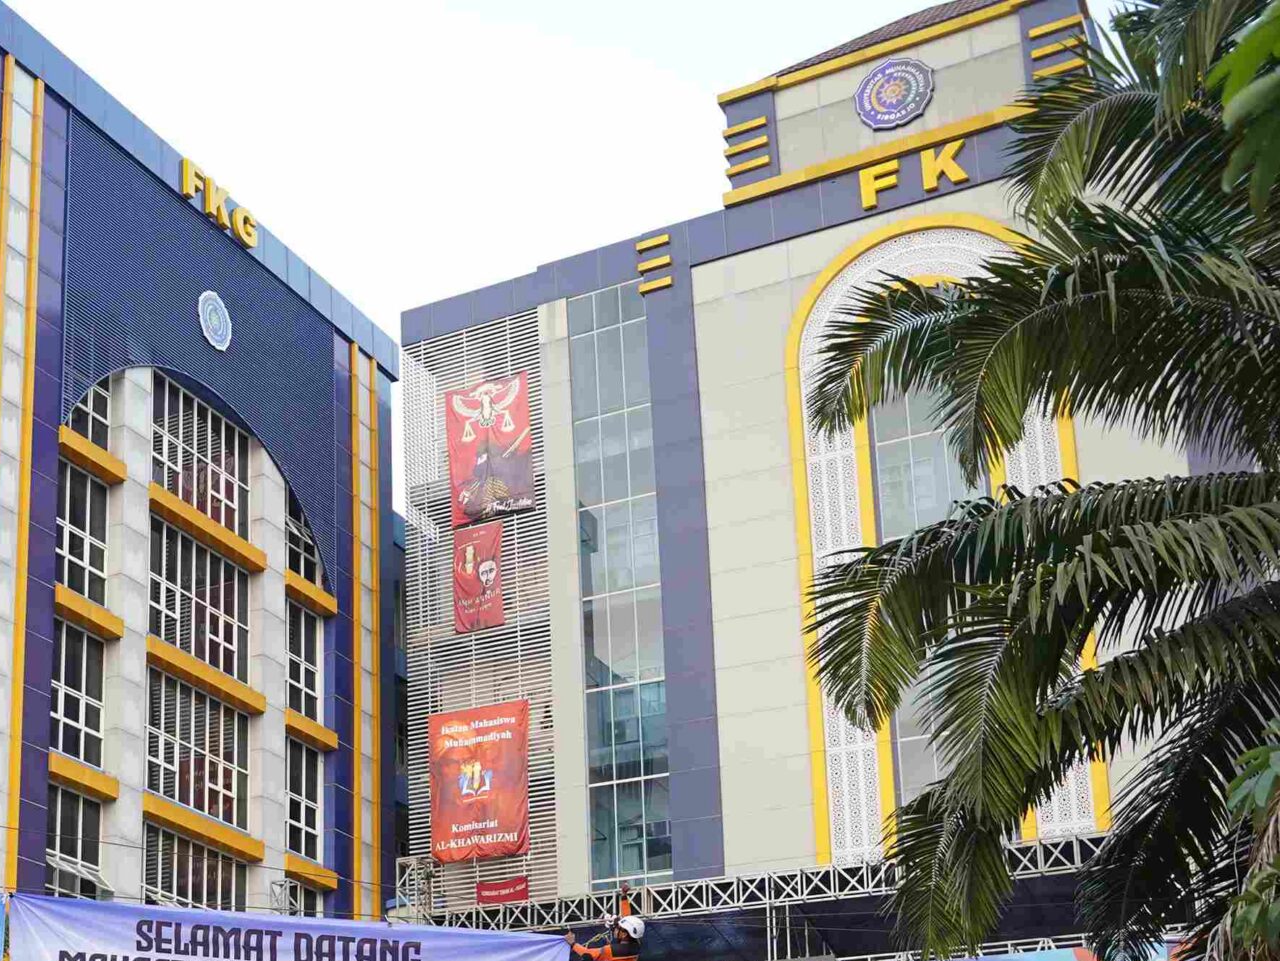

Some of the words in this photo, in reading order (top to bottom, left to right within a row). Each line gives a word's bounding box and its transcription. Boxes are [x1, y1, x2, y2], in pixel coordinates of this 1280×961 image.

[179, 157, 258, 249] FKG
[469, 716, 516, 730] Mahasiswa
[444, 730, 513, 749] Muhammadiyah
[451, 818, 498, 833] Komisariat
[435, 831, 518, 852] AL-KHAWARIZMI
